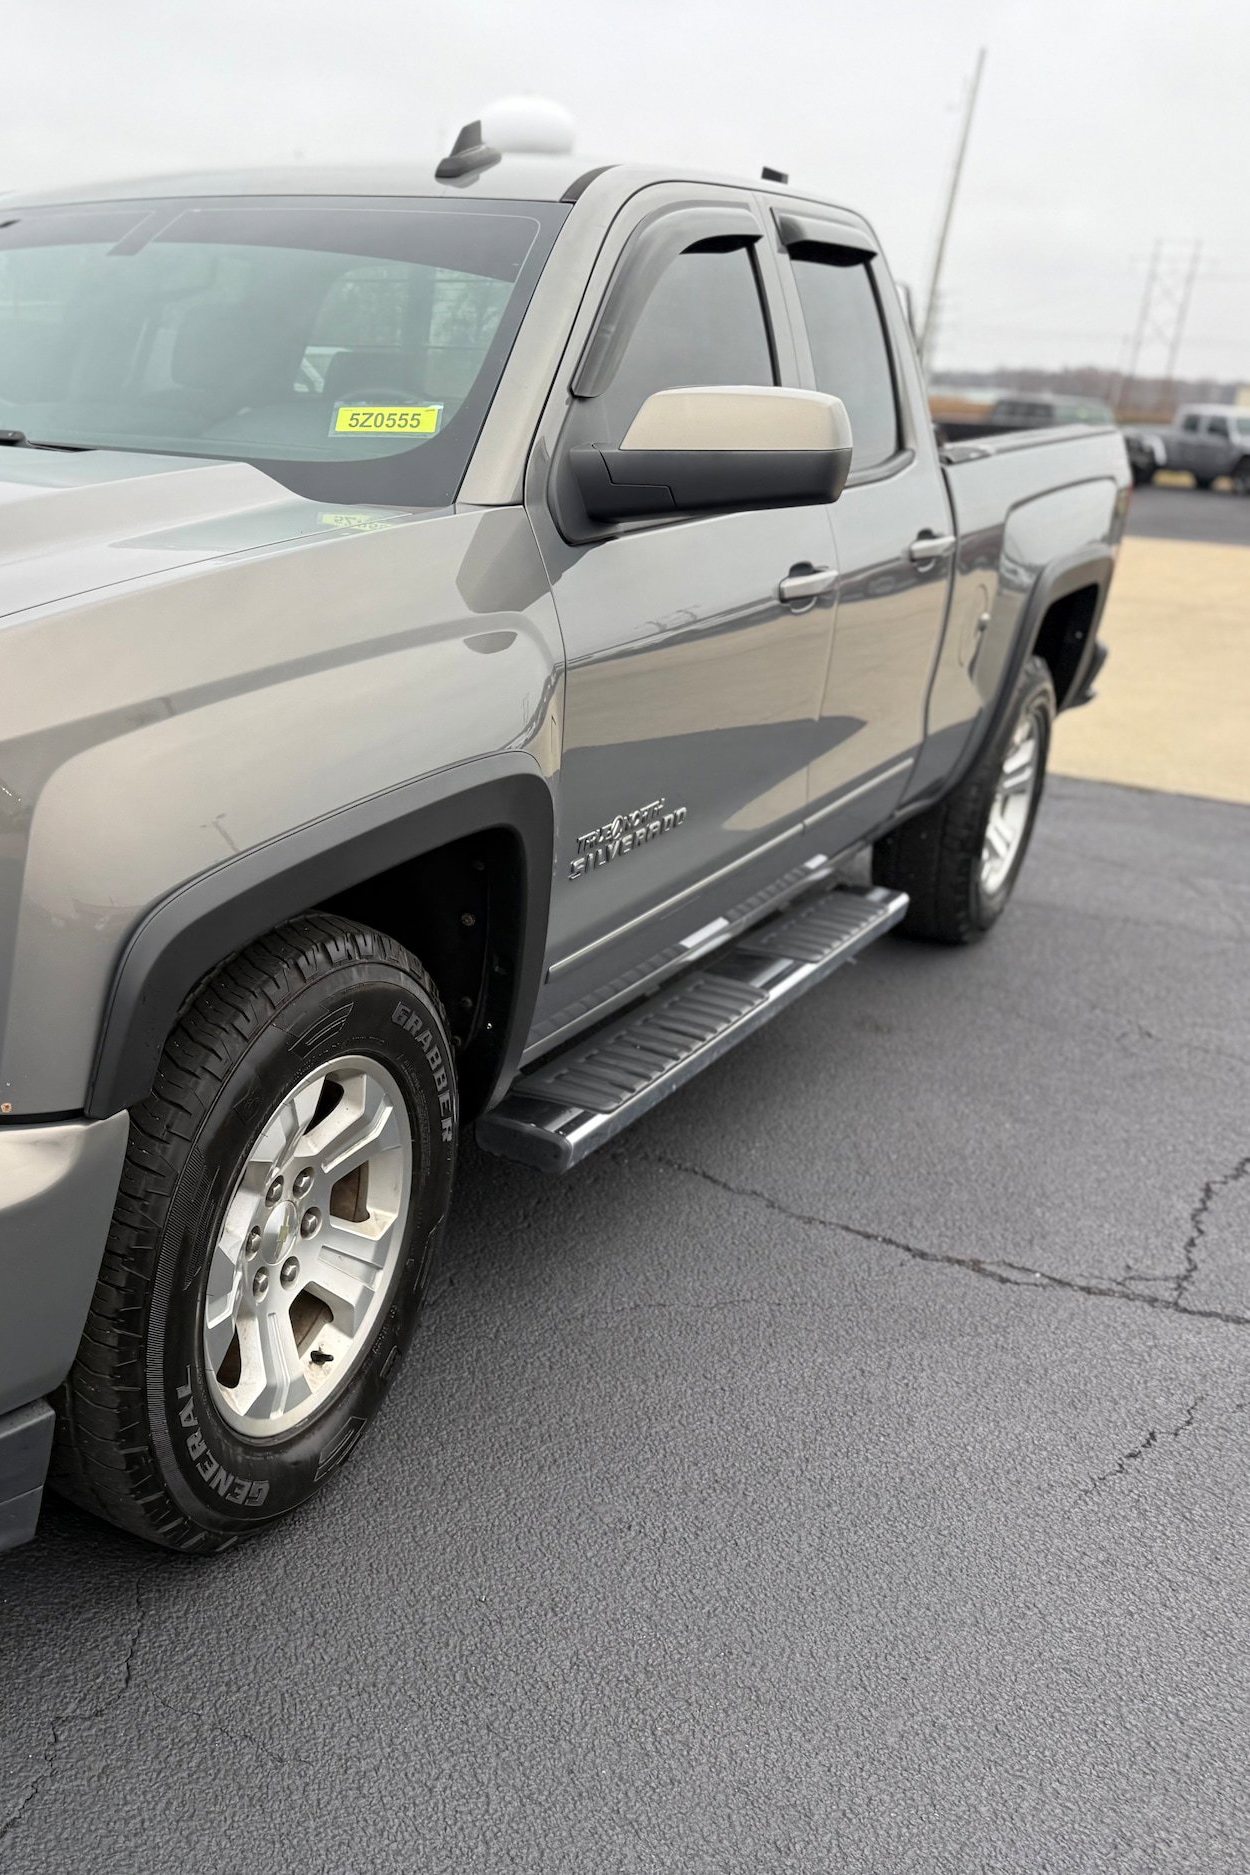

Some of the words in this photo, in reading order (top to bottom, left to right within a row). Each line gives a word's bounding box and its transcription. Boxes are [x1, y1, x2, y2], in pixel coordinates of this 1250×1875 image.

[348, 412, 422, 429] 5Z0555
[567, 806, 688, 880] SILVERADO
[390, 1000, 458, 1143] GRABBER
[175, 1363, 270, 1507] GENERAL
